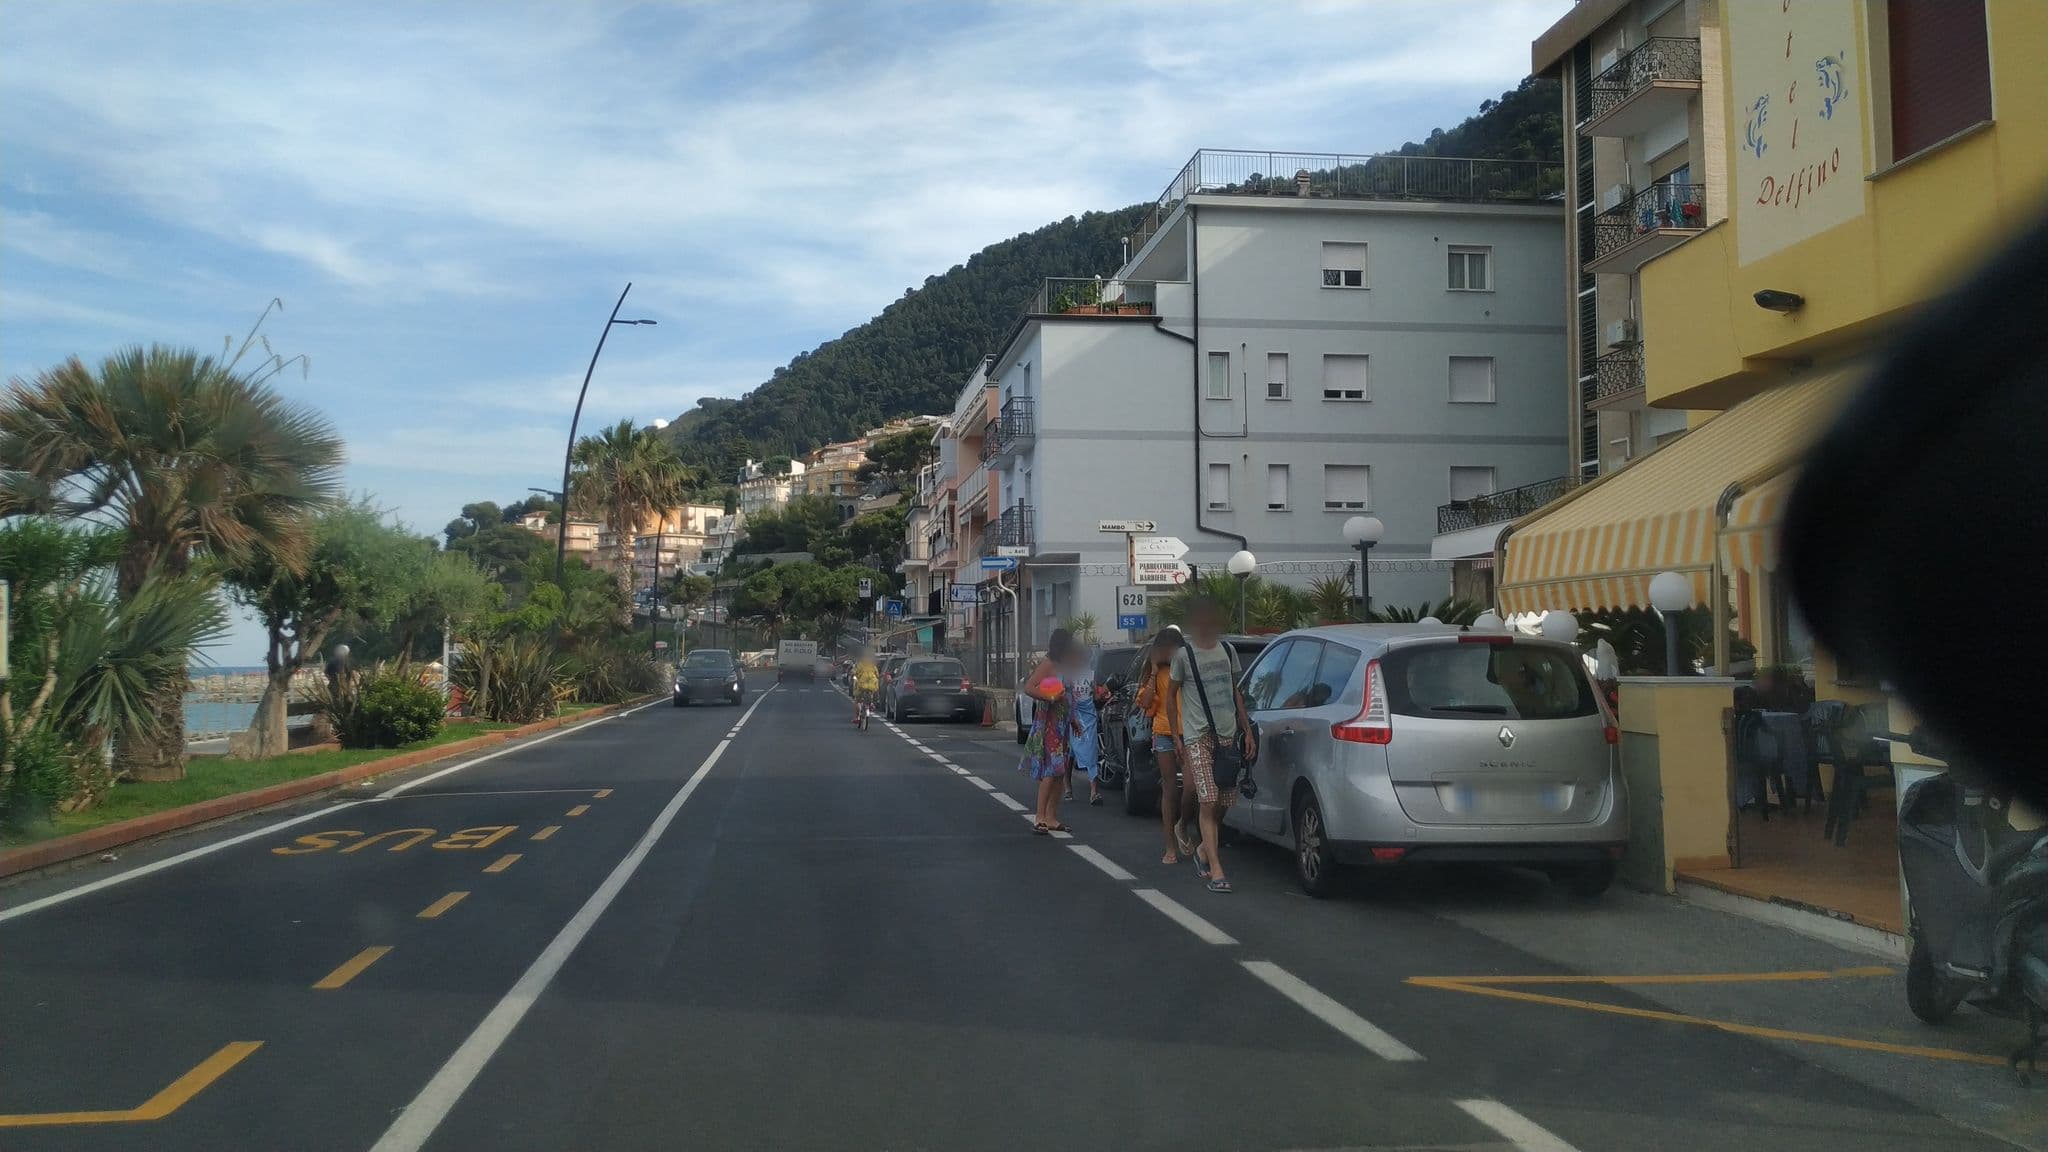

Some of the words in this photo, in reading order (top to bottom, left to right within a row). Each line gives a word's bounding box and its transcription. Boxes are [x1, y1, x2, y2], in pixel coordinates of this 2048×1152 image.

[1756, 147, 1840, 209] Delfino
[1122, 594, 1144, 606] 628
[1123, 617, 1136, 626] SS
[271, 825, 520, 855] BUS
